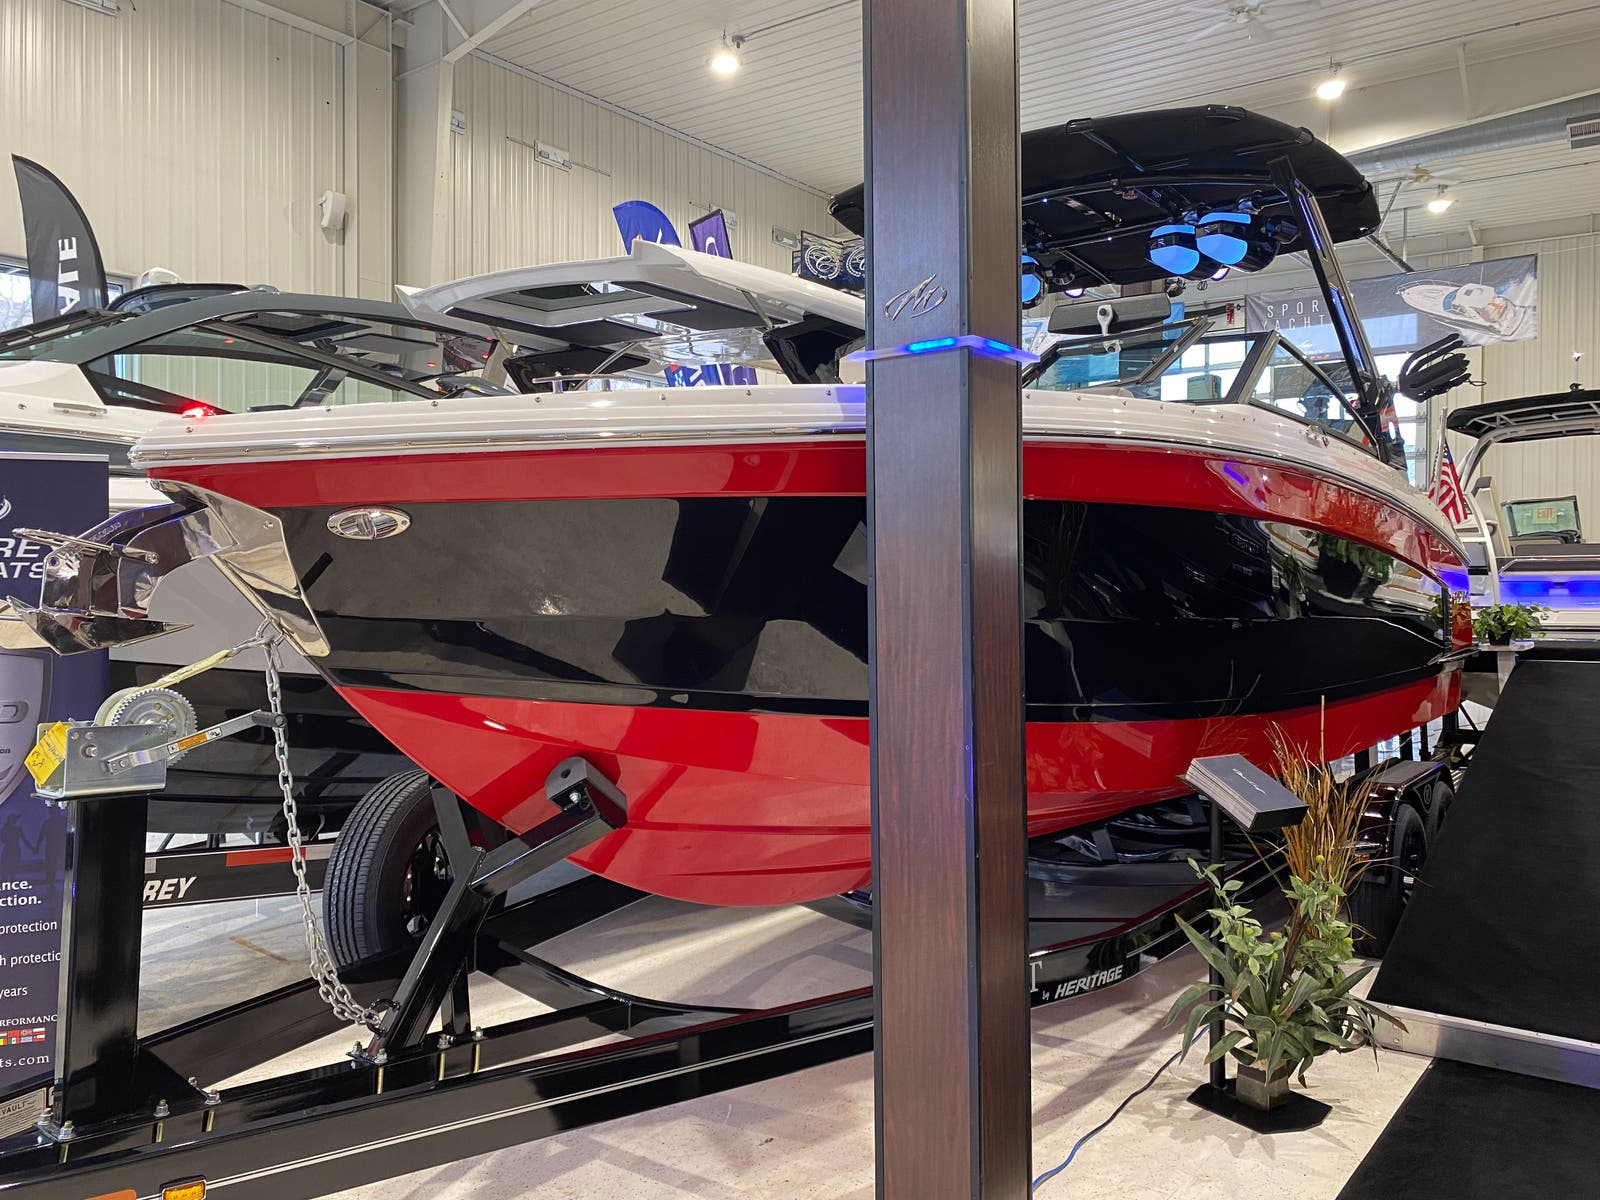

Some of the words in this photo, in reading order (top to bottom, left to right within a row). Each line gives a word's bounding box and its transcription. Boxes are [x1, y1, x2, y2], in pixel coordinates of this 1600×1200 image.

[1266, 299, 1320, 319] SPOR
[1261, 314, 1326, 333] YACHT
[0, 537, 56, 558] RE
[0, 880, 33, 891] nce.
[143, 876, 197, 902] REY
[1054, 964, 1124, 999] HERITAGE
